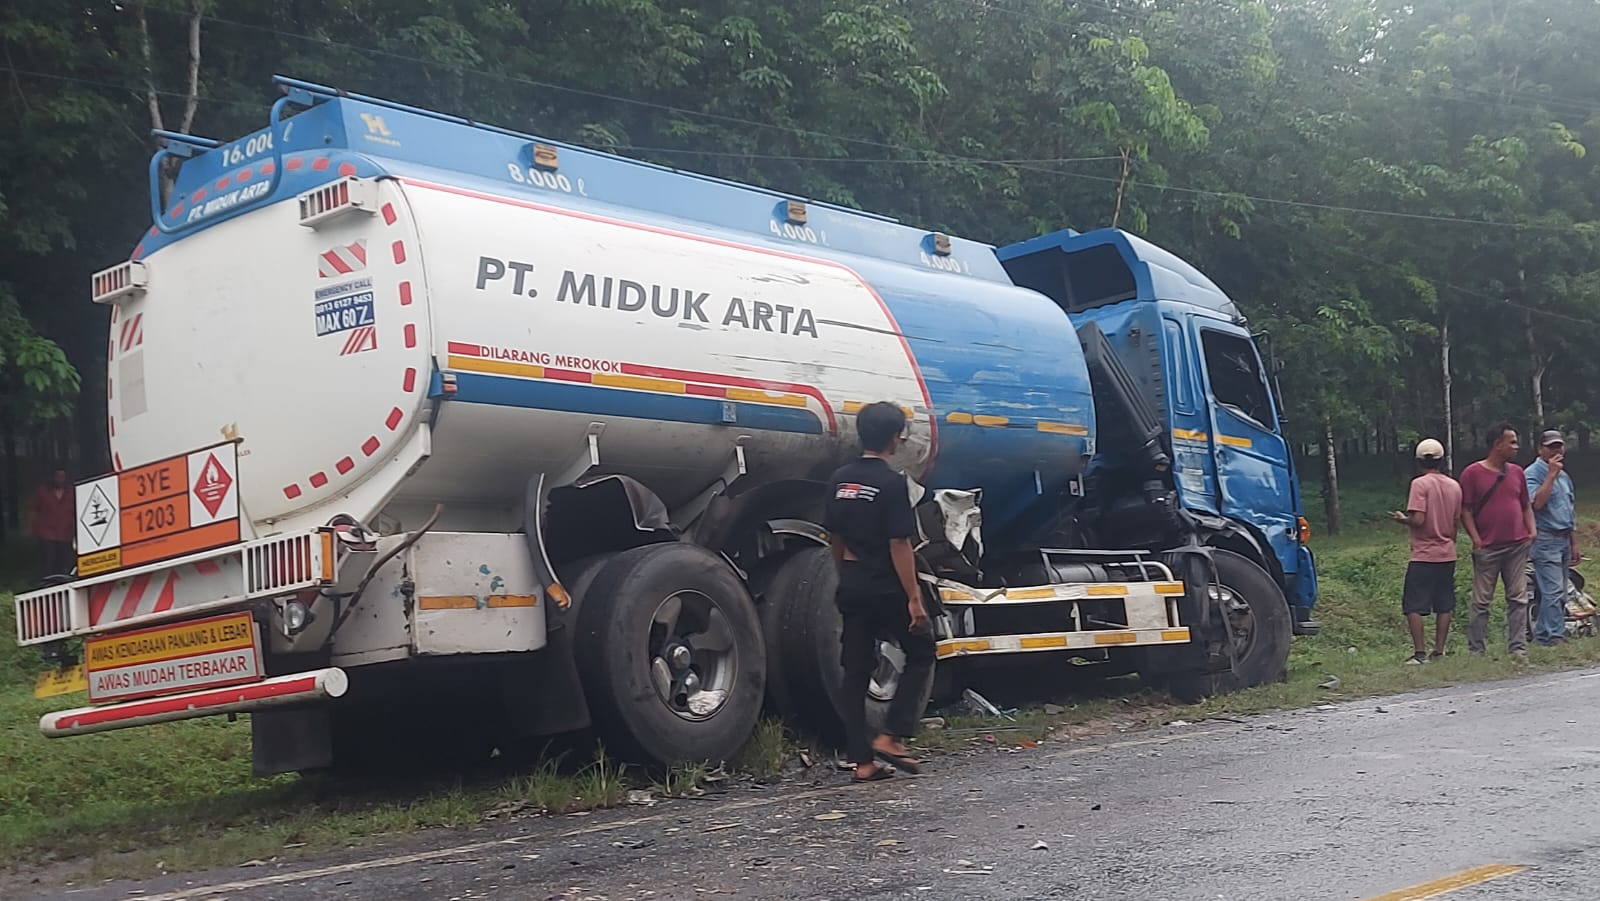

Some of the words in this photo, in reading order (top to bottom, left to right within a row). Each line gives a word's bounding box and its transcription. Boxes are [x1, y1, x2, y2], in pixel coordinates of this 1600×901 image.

[507, 163, 572, 193] 8.000
[203, 190, 239, 215] MIDUK
[239, 180, 272, 202] ARTA
[770, 219, 818, 245] 4.000
[920, 251, 962, 273] 4.000
[475, 256, 539, 299] PT.
[556, 270, 711, 323] MIDUK
[722, 297, 819, 338] ARTA
[316, 311, 342, 333] MAX
[342, 308, 356, 328] 60
[481, 346, 550, 365] DILARANG
[555, 355, 620, 373] MEROKOK
[136, 467, 171, 496] 3YE
[135, 504, 175, 533] 1203
[92, 646, 114, 662] AWAS
[115, 638, 167, 658] KENDARAAN
[168, 630, 209, 650] PANJANG
[210, 628, 218, 643] &
[218, 623, 249, 641] LEBAR
[97, 673, 130, 691] AWAS
[133, 665, 176, 686] MUDAH
[179, 655, 247, 678] TERBAKAR
